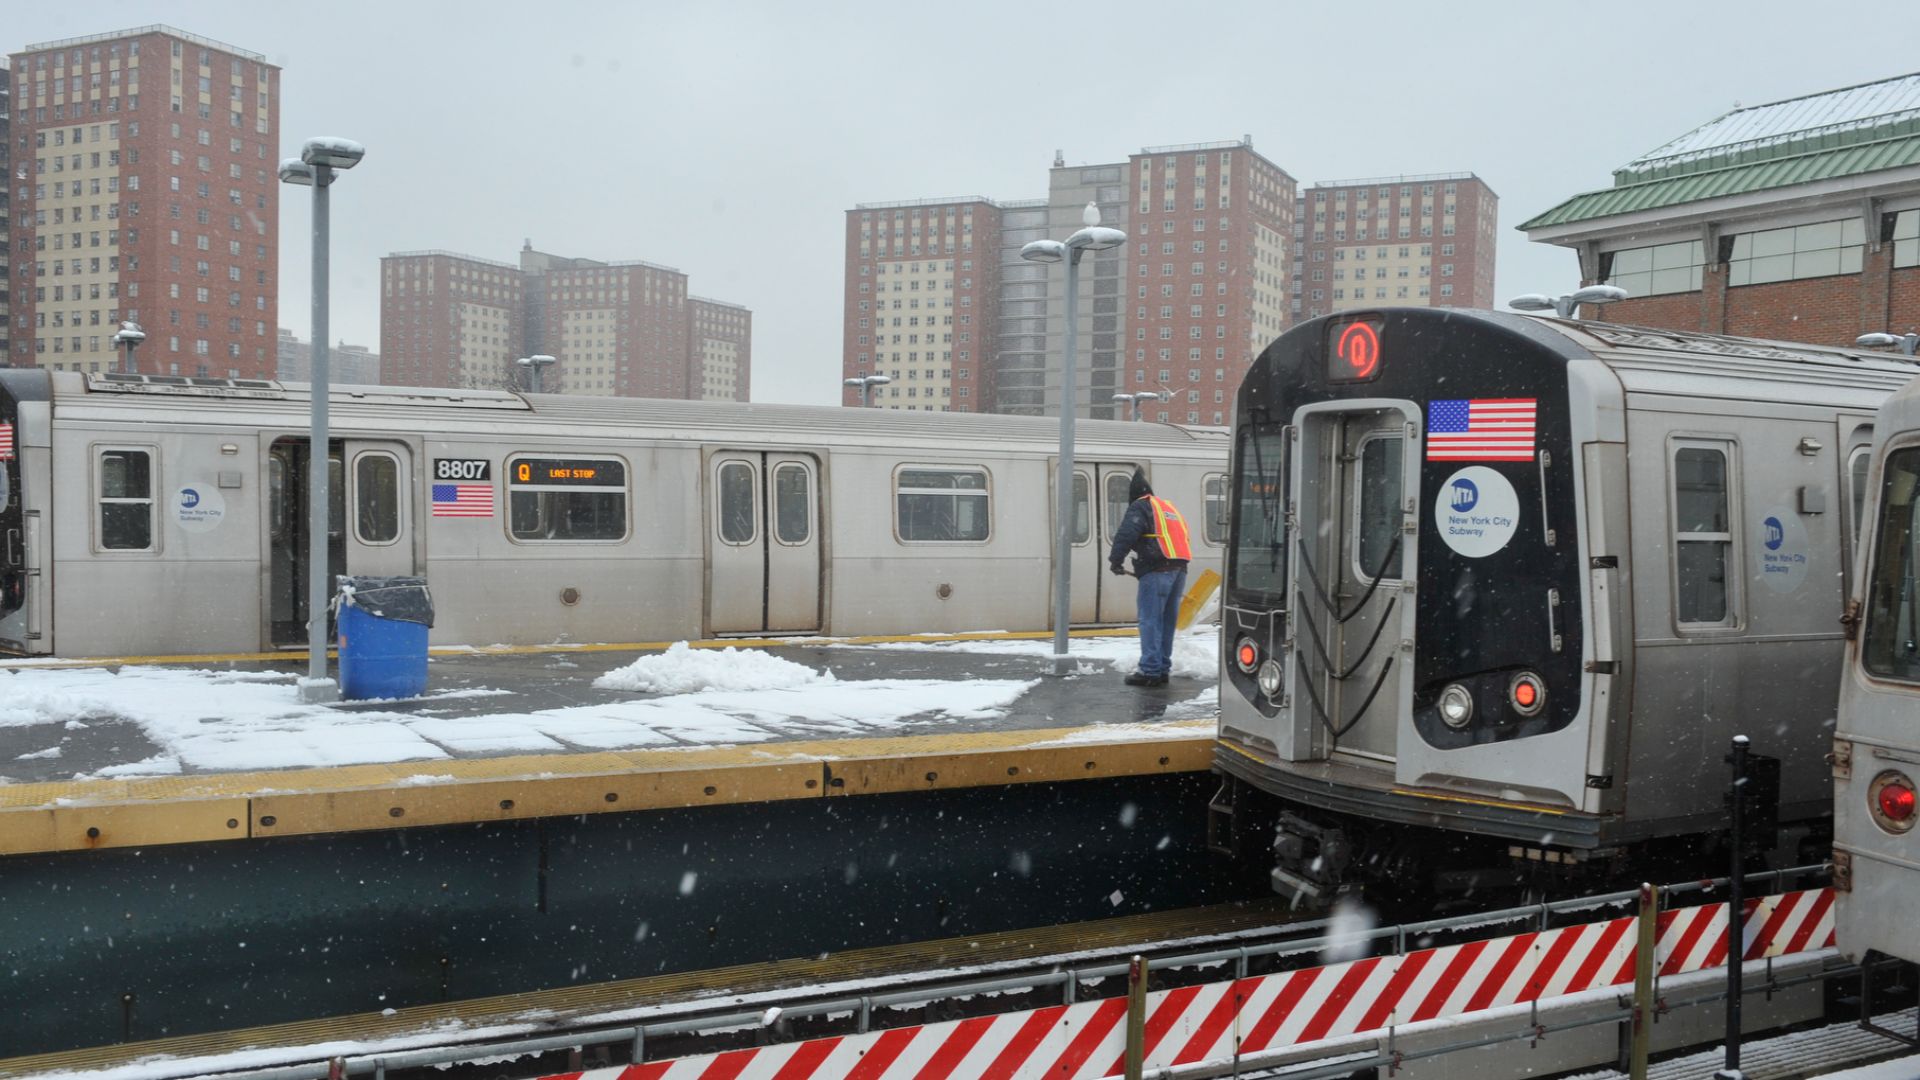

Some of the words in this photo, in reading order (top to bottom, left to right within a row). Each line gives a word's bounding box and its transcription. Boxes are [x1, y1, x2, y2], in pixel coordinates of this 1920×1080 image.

[437, 460, 487, 479] 8807
[518, 463, 531, 481] Q
[549, 468, 571, 478] LAST
[573, 469, 595, 479] STOP
[1450, 485, 1474, 507] MTA
[1449, 515, 1468, 525] New
[1471, 516, 1491, 526] York
[1492, 516, 1512, 528] City
[1449, 526, 1484, 537] Subway
[1764, 553, 1778, 562] New
[1793, 553, 1807, 565] City
